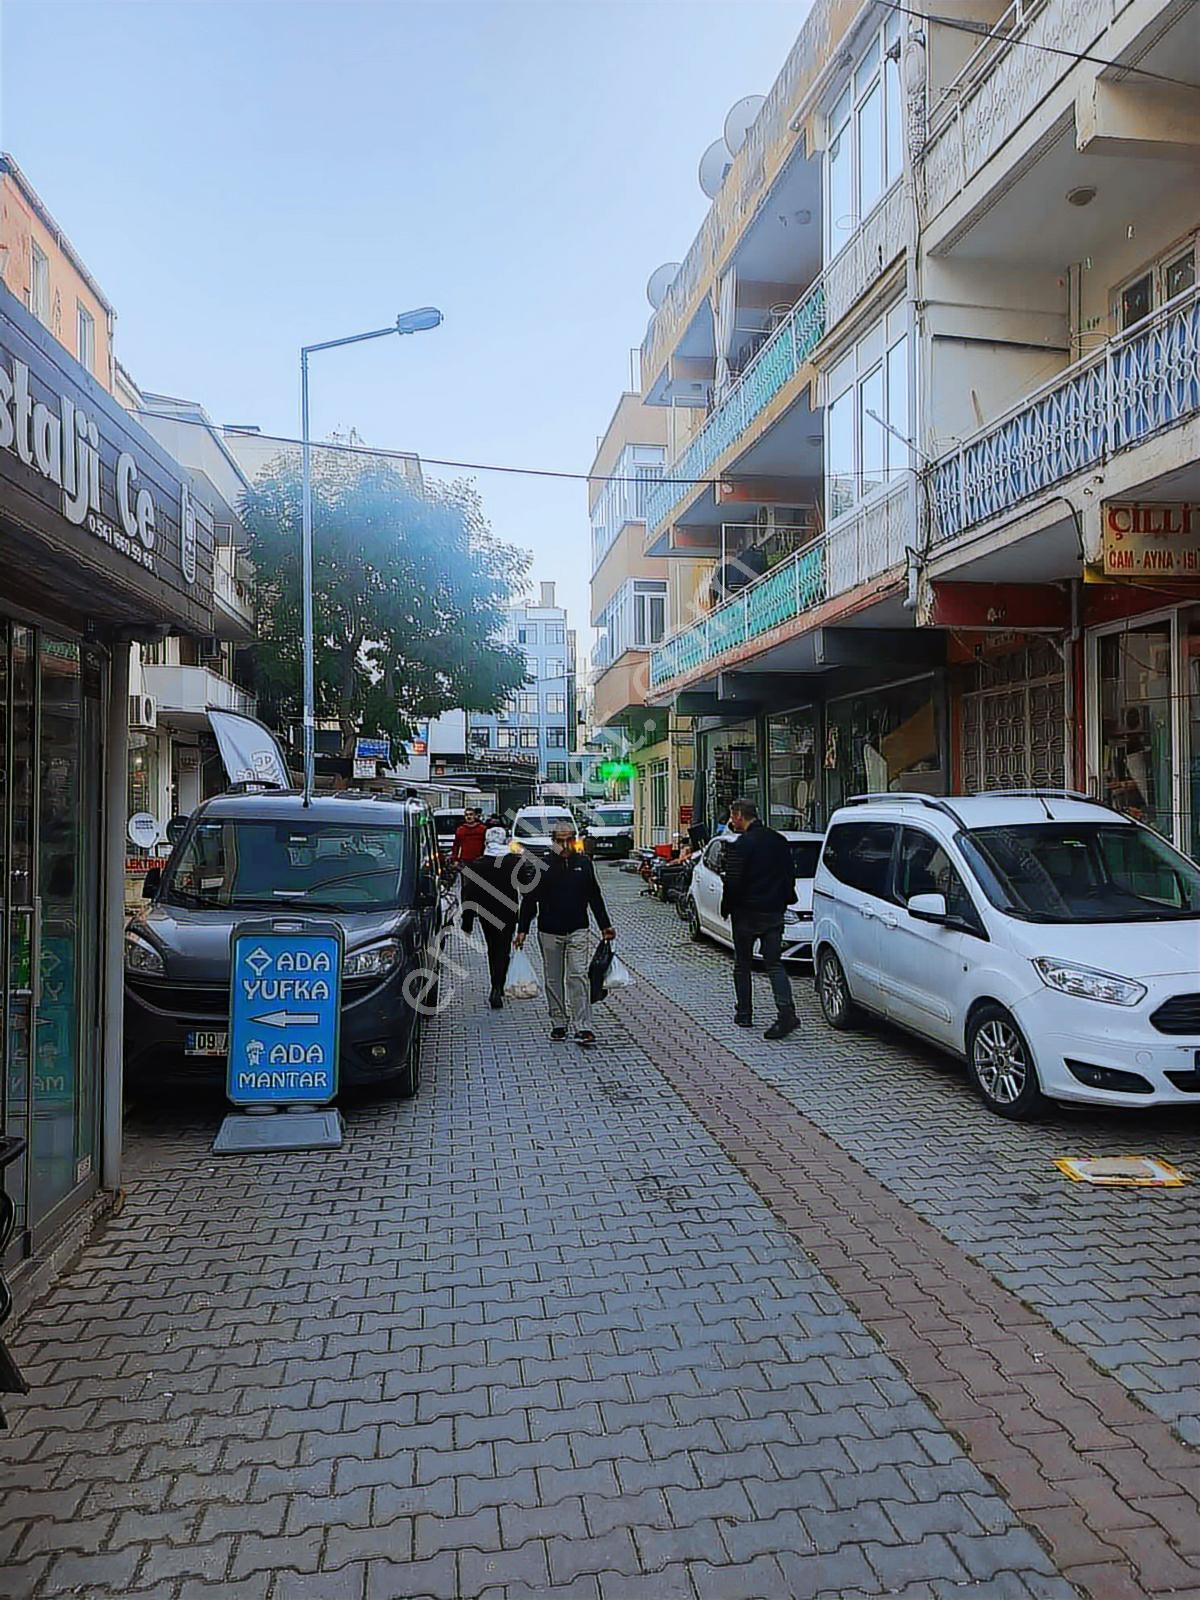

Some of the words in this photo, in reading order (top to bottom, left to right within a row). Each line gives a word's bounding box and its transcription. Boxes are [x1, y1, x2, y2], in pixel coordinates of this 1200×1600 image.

[1109, 550, 1134, 569] CAM
[1143, 550, 1174, 569] AYNA
[276, 952, 332, 971] ADA
[243, 980, 329, 1000] YUFKA
[198, 1033, 216, 1050] 09
[269, 1044, 324, 1064] ADA
[238, 1071, 328, 1089] MANTAR
